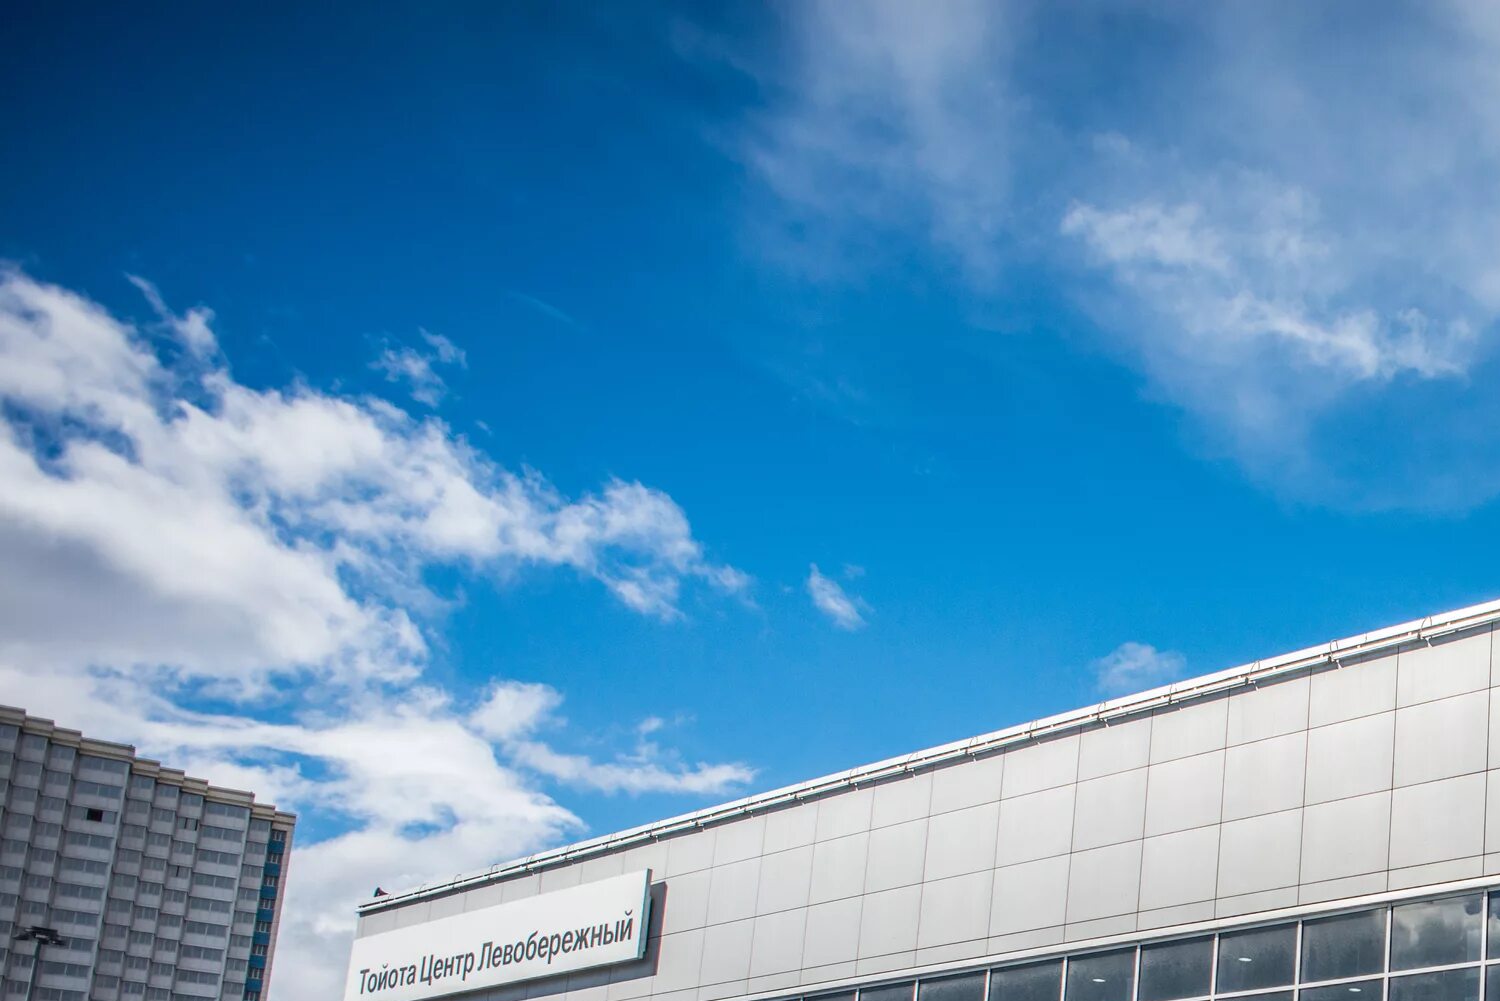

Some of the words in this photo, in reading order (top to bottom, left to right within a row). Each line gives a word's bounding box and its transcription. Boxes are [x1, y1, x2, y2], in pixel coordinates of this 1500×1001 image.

[360, 963, 416, 995] Тойота
[420, 951, 474, 985] Центр
[477, 909, 634, 972] Левобережный
